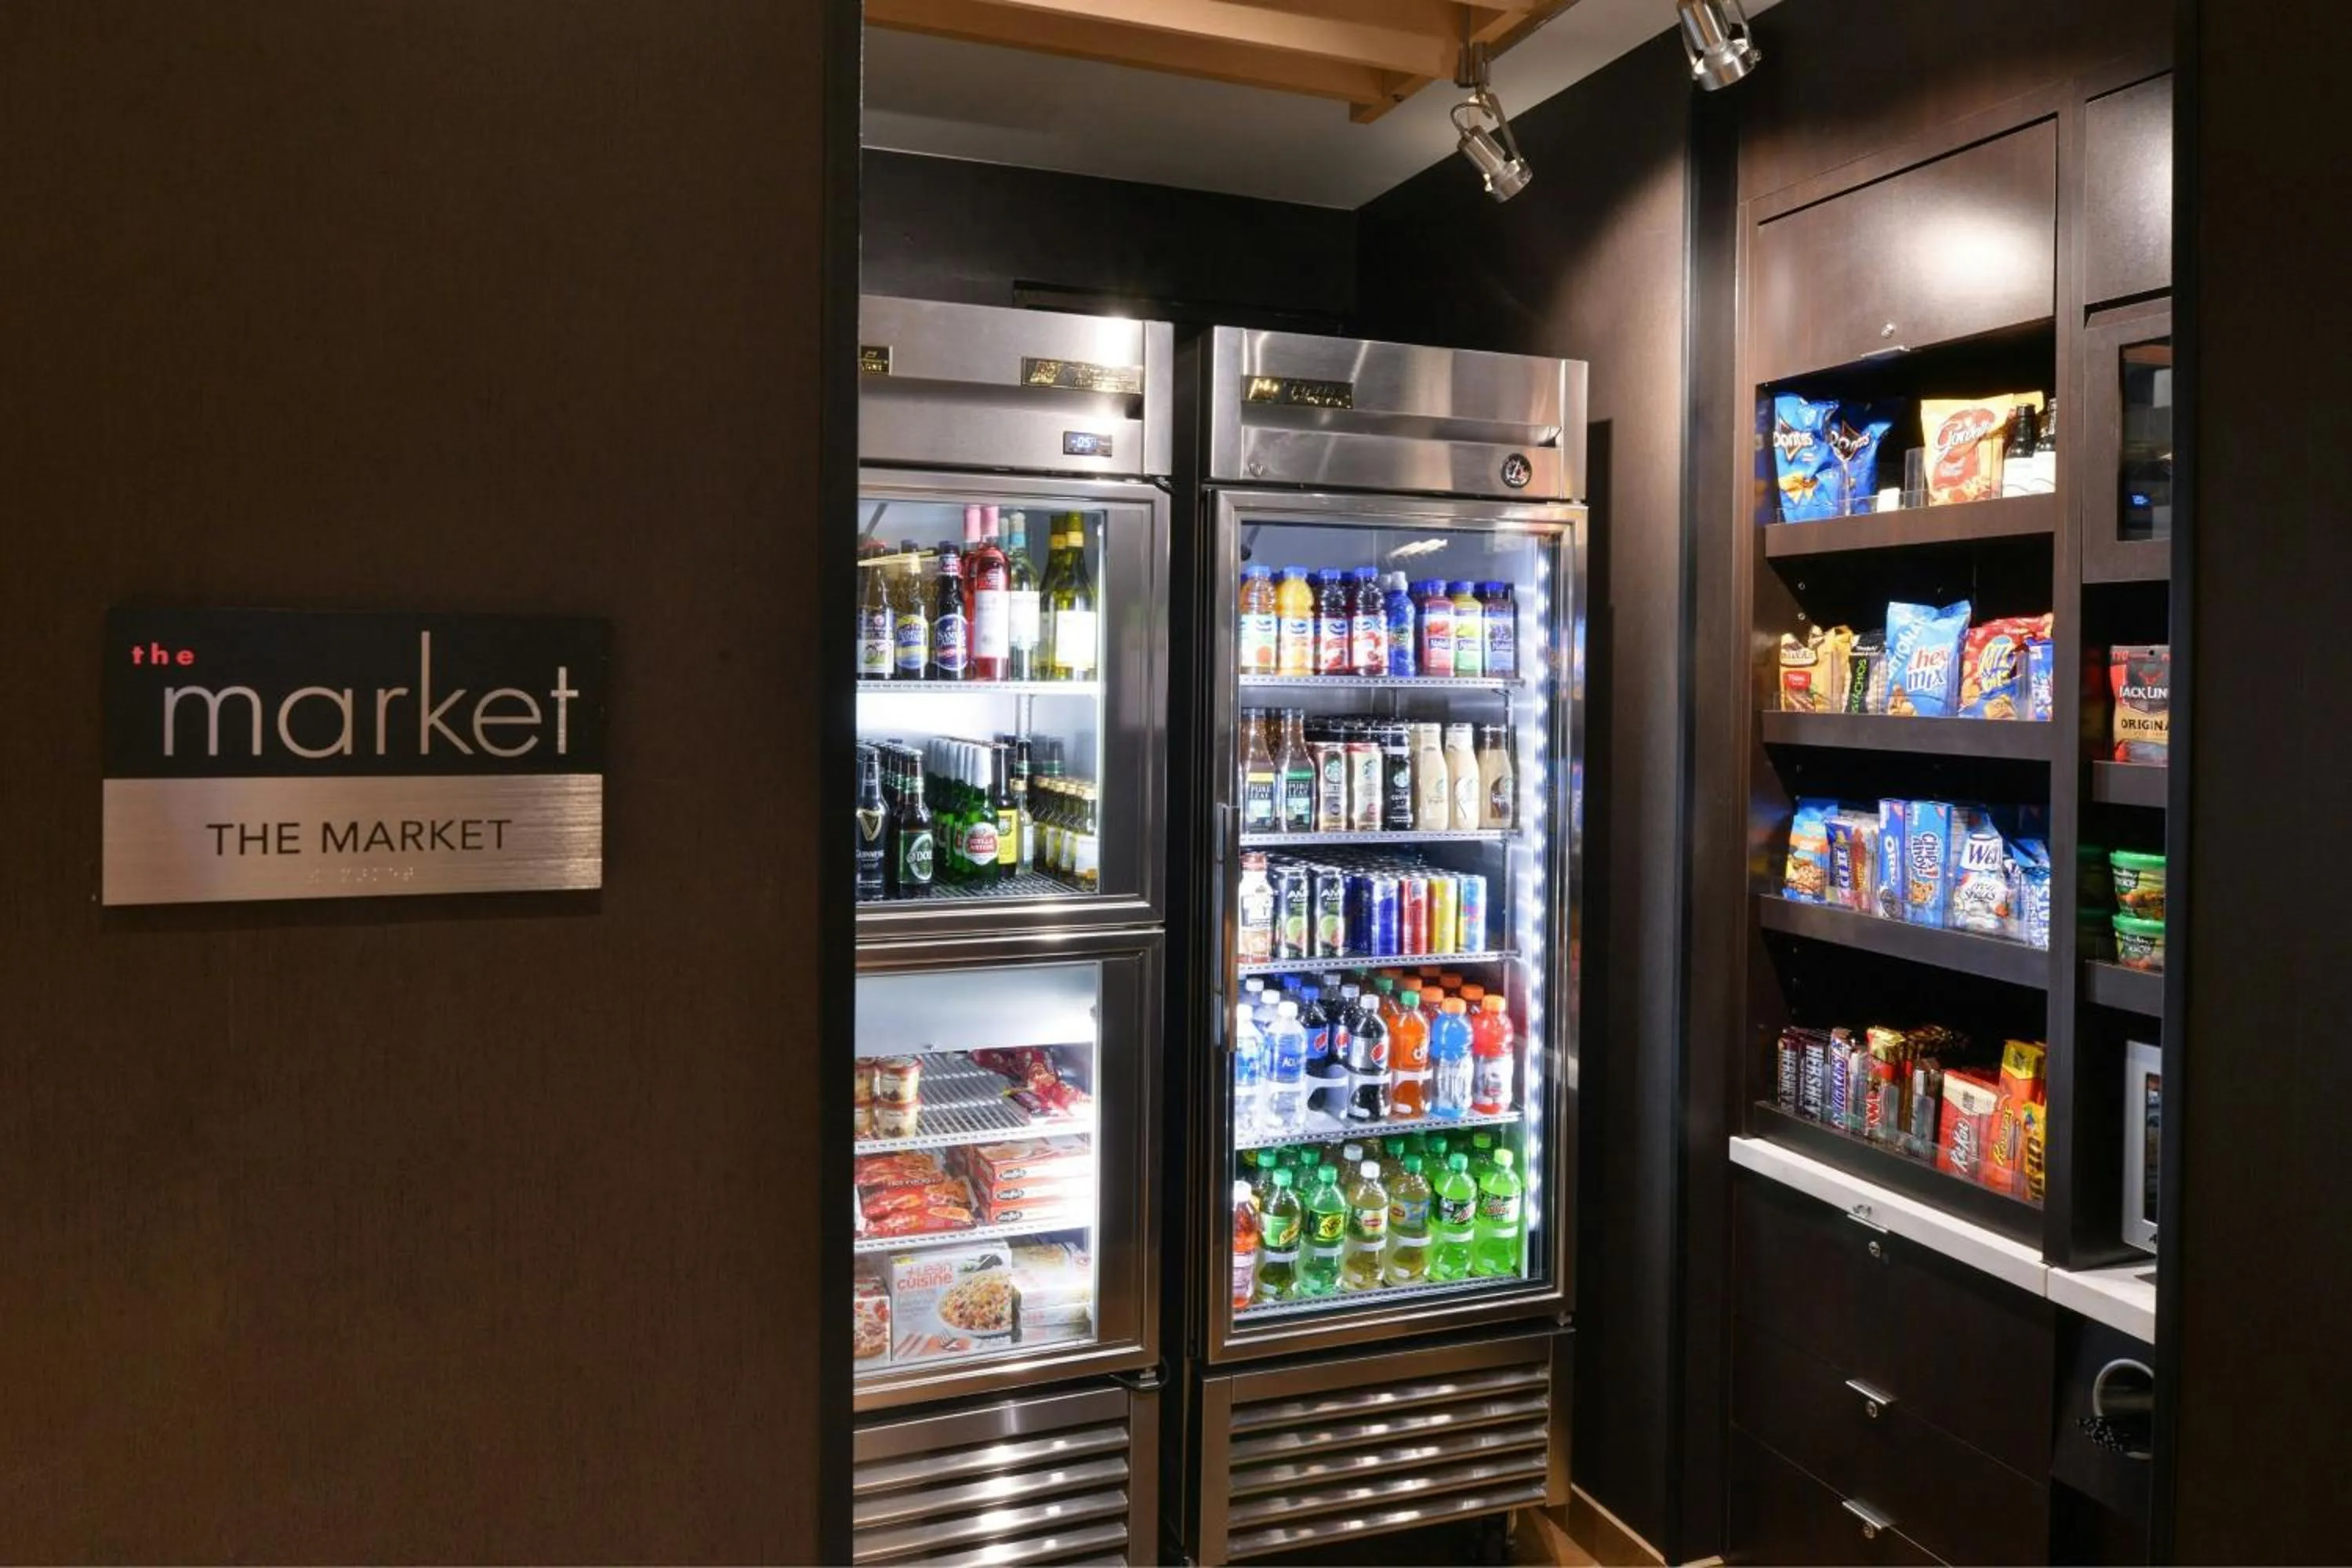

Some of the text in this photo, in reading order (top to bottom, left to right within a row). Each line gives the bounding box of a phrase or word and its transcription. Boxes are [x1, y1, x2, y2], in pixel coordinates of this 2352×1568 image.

[132, 643, 194, 666] the
[164, 630, 579, 757] market
[2119, 686, 2145, 699] JACK
[2121, 718, 2168, 731] ORIGIN
[206, 823, 300, 855] THE
[321, 819, 512, 854] MARKET
